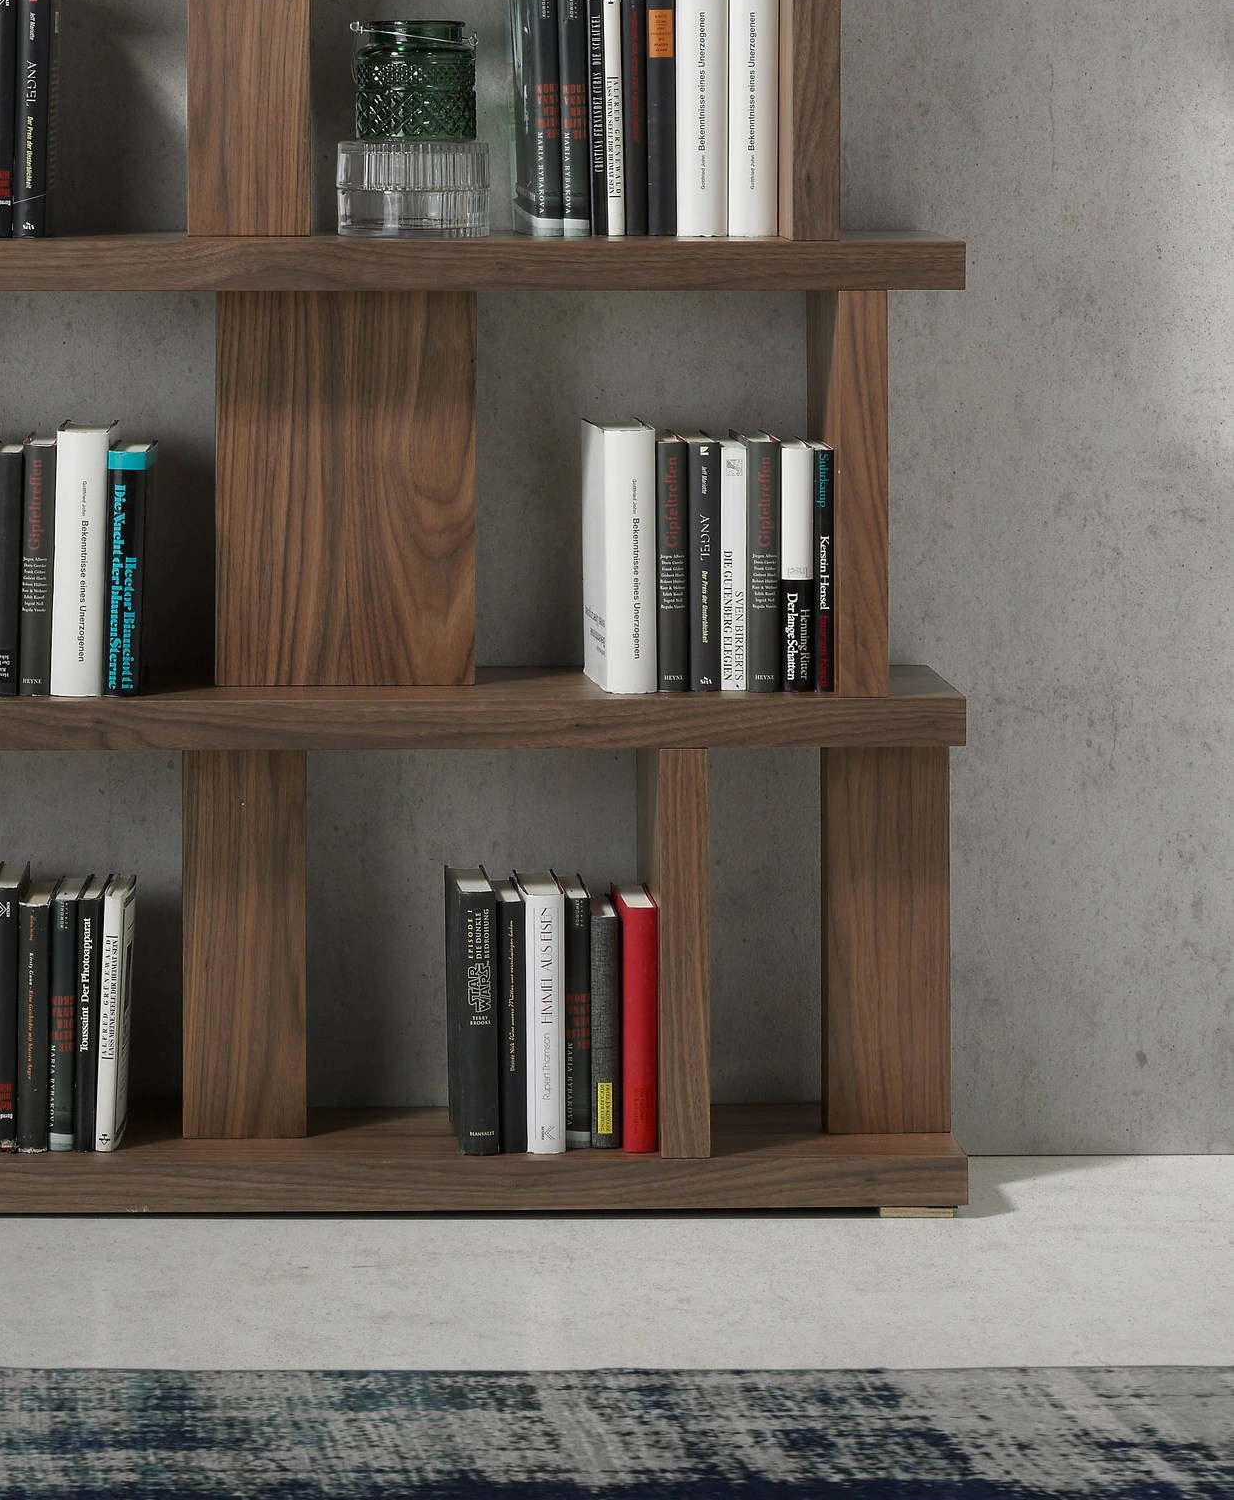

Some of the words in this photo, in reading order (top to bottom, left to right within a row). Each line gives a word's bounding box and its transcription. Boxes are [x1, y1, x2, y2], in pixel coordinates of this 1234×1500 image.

[590, 14, 601, 50] SCHAUKEL
[698, 11, 707, 68] Unerzogenen
[591, 52, 602, 65] DIE
[25, 59, 37, 107] ANGEL
[592, 72, 603, 93] CUBAS
[698, 69, 706, 92] eines
[26, 116, 34, 125] Der
[26, 127, 34, 139] Preis
[593, 96, 603, 137] FERNANDEZ
[698, 94, 706, 151] Bekenntnisse
[25, 150, 33, 189] Unsterblichkeit
[593, 140, 604, 173] CRISTINA
[113, 484, 127, 511] Die
[816, 453, 829, 508] Suhrkamp
[28, 459, 46, 552] Gipfeltreffen
[665, 456, 681, 548] Gipfeltreffen
[113, 512, 126, 556] Nacht
[111, 557, 123, 585] der
[723, 551, 732, 568] DIE
[787, 567, 811, 578] Insel
[819, 536, 829, 572] Kerstin
[124, 556, 137, 611] Hector
[723, 570, 732, 633] GUTENBERG
[787, 592, 799, 613] Der
[819, 574, 829, 610] Hensel
[110, 585, 122, 637] blauen
[734, 591, 743, 622] SVEN
[785, 613, 799, 639] lange
[797, 608, 811, 651] Henning
[108, 637, 122, 690] Sterne
[121, 611, 136, 690] Bianciotti
[723, 636, 732, 681] ELEGIEN
[734, 625, 743, 681] BIRKERTS
[787, 639, 799, 681] Schatten
[800, 652, 810, 681] Ritter
[540, 907, 553, 942] EISEN
[81, 917, 93, 983] Photoapparat
[540, 945, 553, 972] AUS
[80, 983, 90, 1003] Der
[467, 963, 481, 1011] STAR
[477, 963, 492, 1013] WARS
[540, 975, 553, 1024] HIMMEL
[79, 1006, 89, 1053] Toussaint
[542, 1032, 551, 1071] Thomson
[542, 1072, 552, 1101] Rupert
